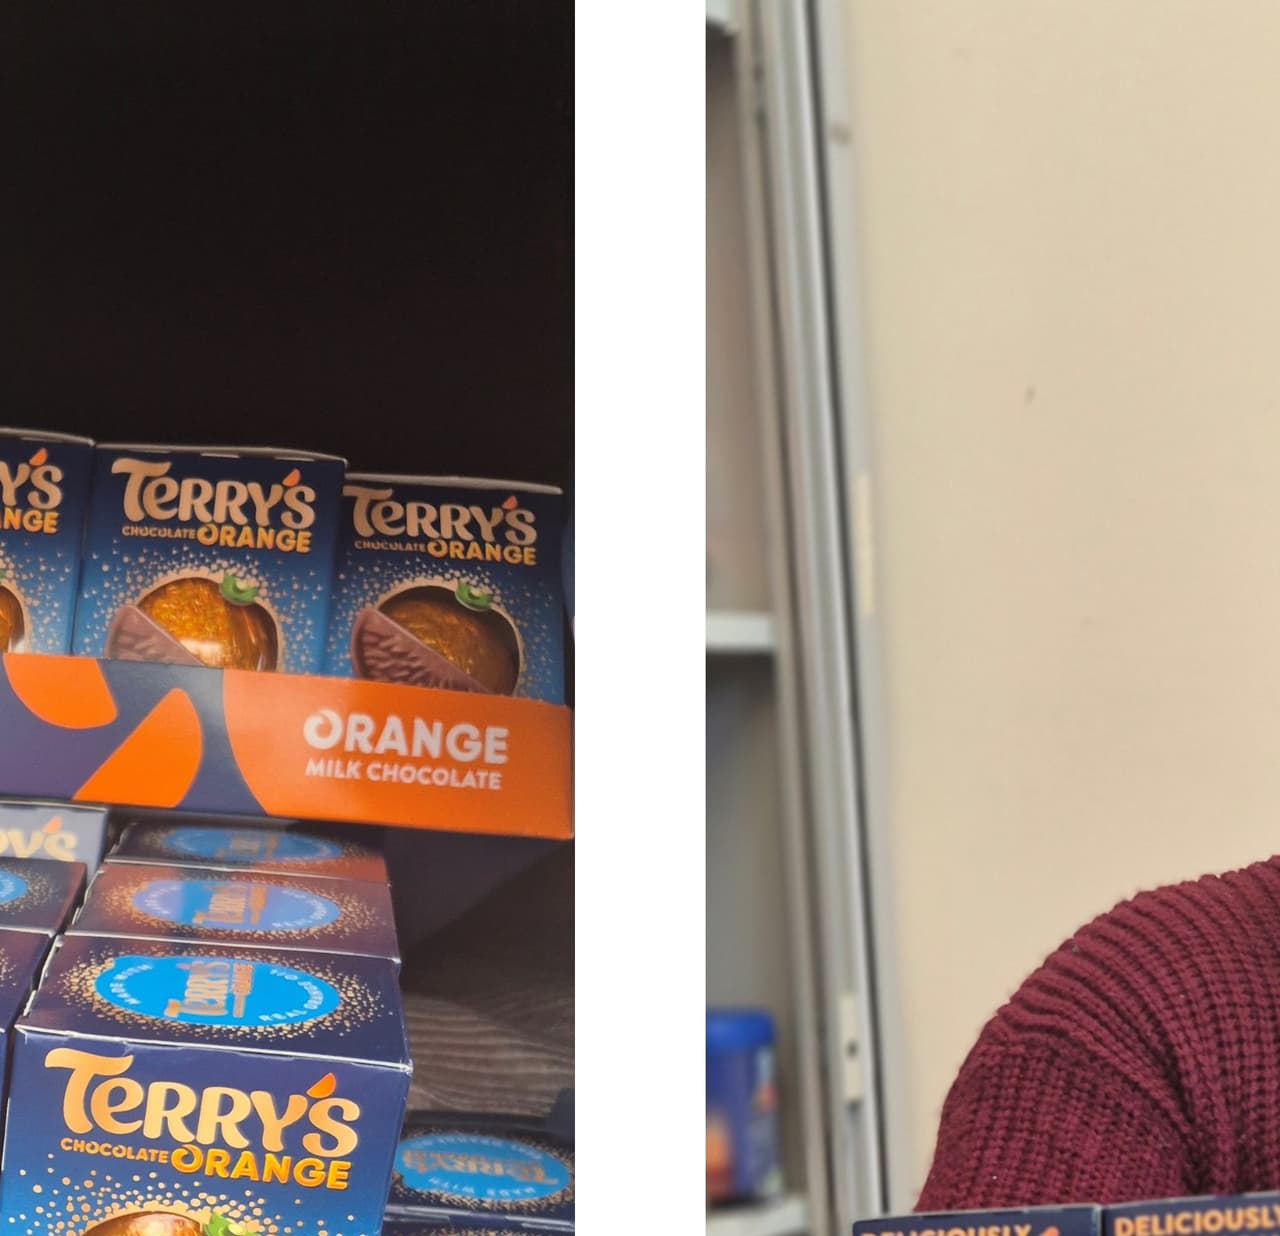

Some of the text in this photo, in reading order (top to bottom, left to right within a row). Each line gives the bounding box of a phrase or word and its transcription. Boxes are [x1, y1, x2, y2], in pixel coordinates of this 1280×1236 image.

[197, 523, 312, 554] ORANGE
[426, 537, 537, 566] ORANGE
[303, 709, 510, 765] ORANGE
[305, 758, 503, 791] MILK CHOCOLATE
[60, 1137, 353, 1192] CHOCOLATE ORANGE
